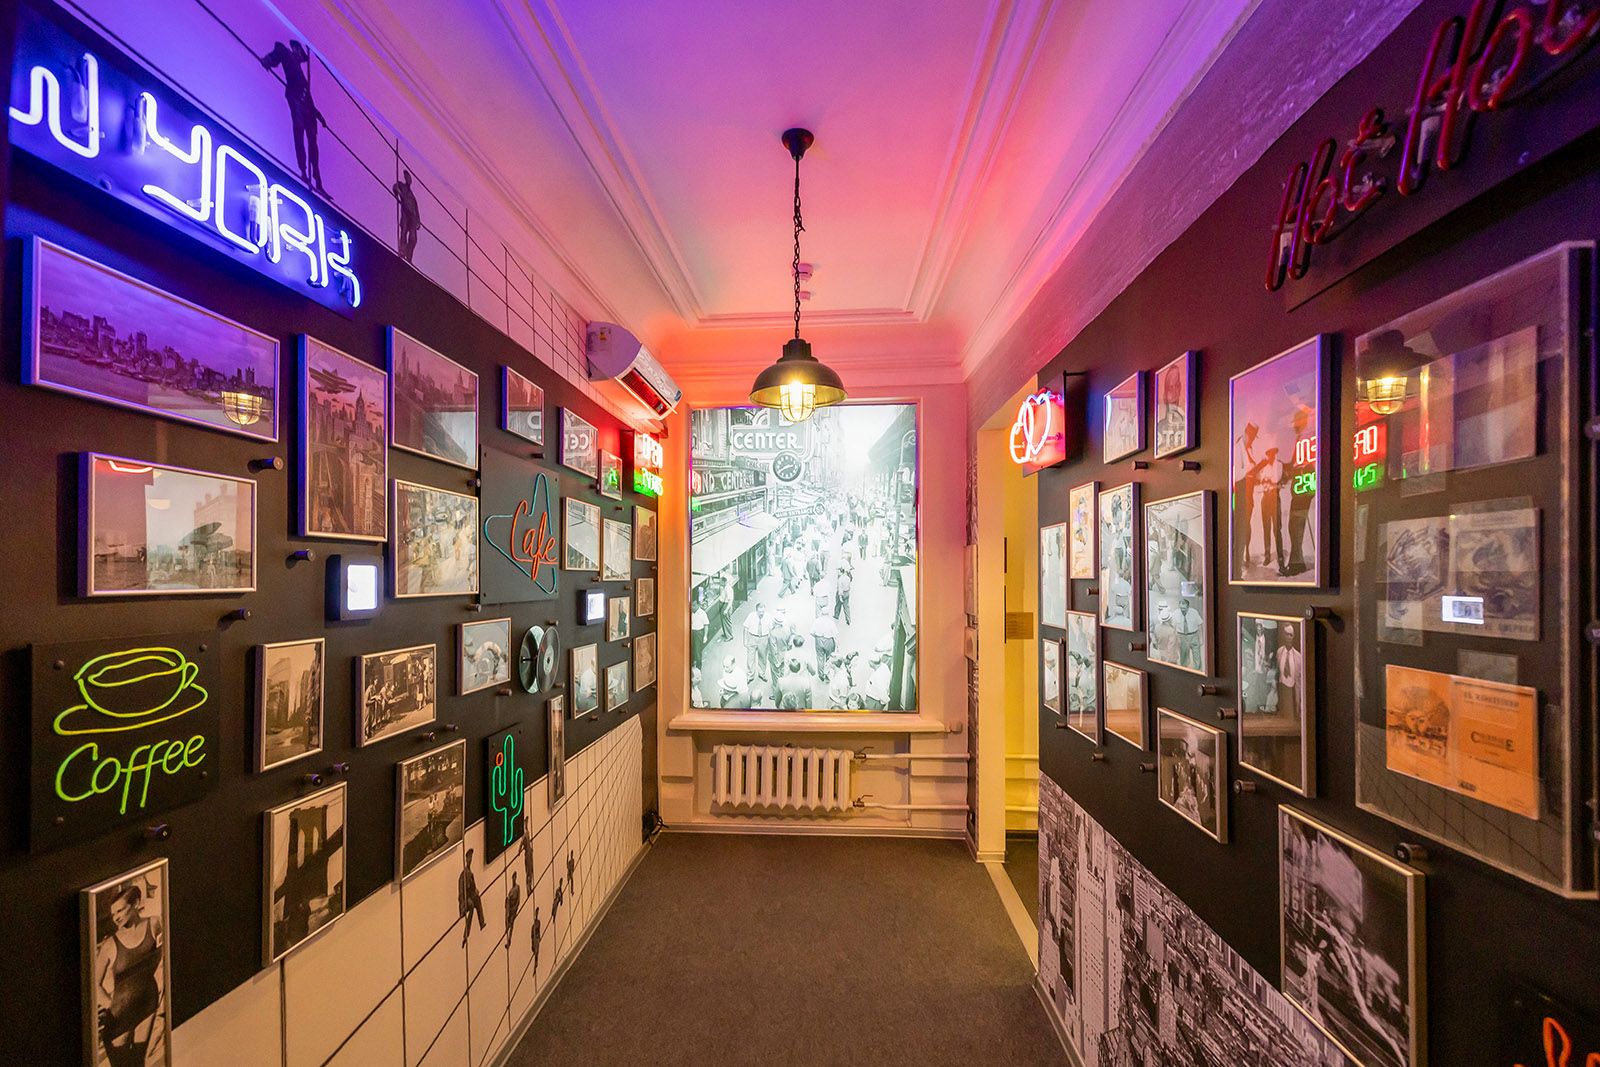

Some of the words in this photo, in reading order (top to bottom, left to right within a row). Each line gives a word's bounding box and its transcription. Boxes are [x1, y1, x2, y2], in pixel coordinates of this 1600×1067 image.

[142, 91, 361, 308] YORK
[733, 432, 798, 449] CENTER
[510, 499, 559, 580] Cafe
[55, 735, 207, 814] Coffee
